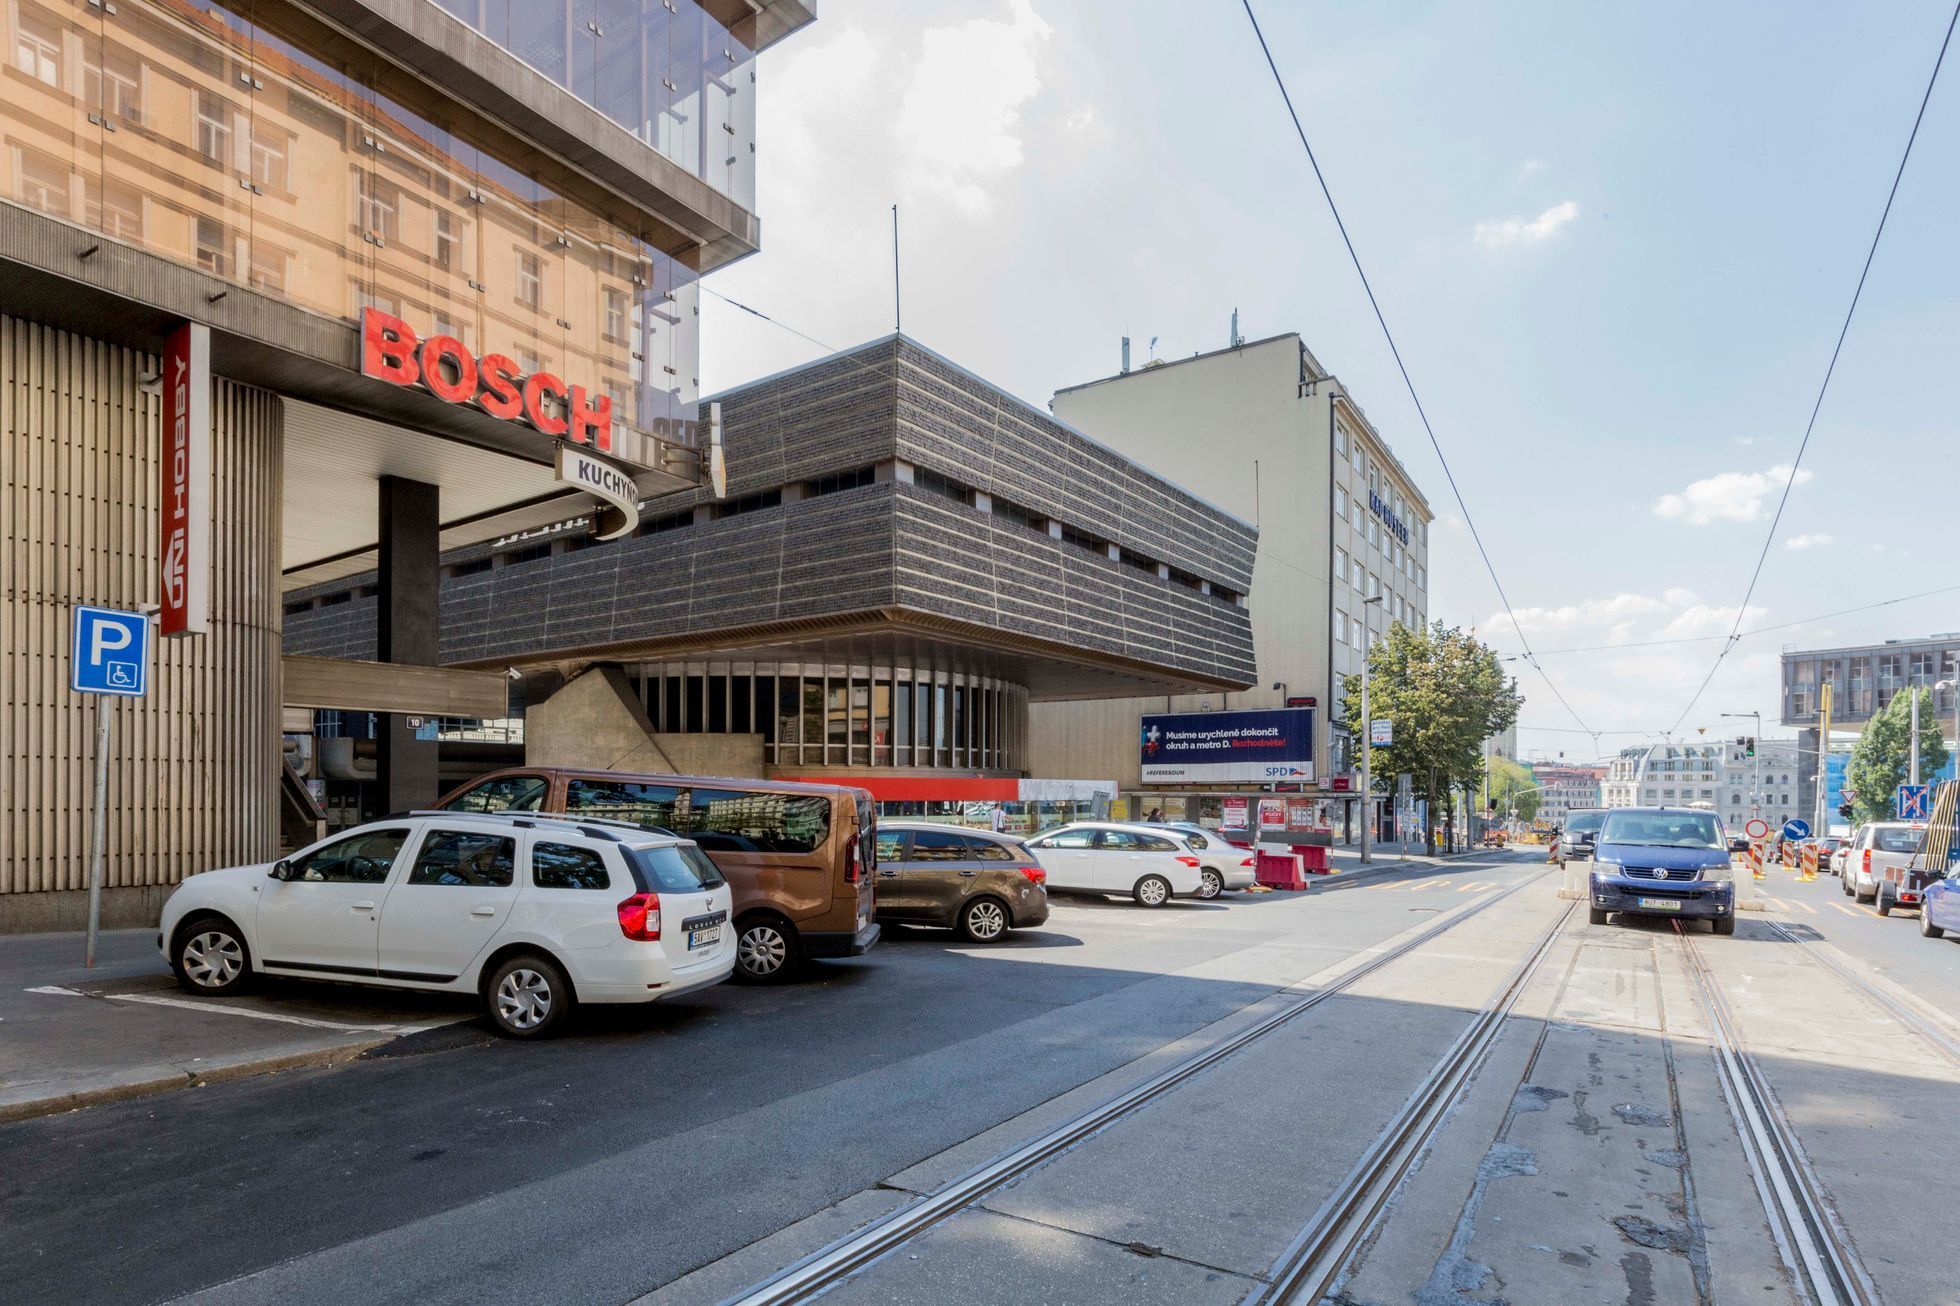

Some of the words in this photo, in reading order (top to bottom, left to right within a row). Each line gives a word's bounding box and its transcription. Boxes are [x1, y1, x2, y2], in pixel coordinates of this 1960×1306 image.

[361, 305, 612, 452] BOSCH
[174, 354, 186, 520] HOBBY
[172, 528, 185, 609] UNI
[91, 619, 132, 666] P
[411, 719, 420, 727] 10
[1198, 729, 1240, 740] urychleně
[1240, 727, 1279, 737] dokončit
[1166, 741, 1189, 750] okruh
[1196, 740, 1221, 749] metro
[1222, 740, 1231, 748] D.
[1265, 767, 1288, 776] SPD
